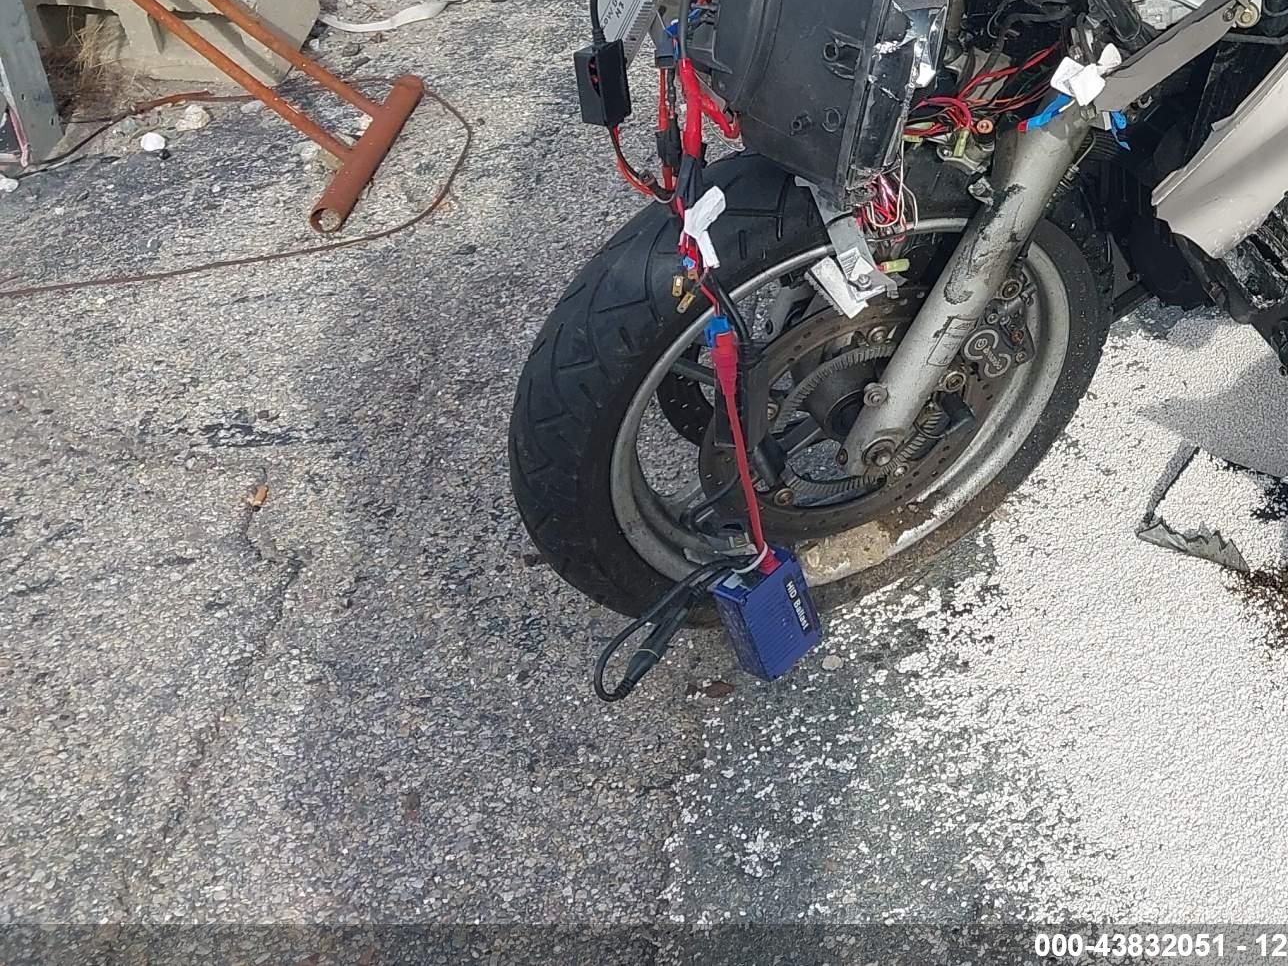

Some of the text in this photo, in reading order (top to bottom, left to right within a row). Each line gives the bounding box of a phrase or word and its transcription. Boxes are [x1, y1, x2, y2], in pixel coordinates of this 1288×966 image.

[614, 1, 625, 19] H7
[785, 580, 810, 631] HID Ballast
